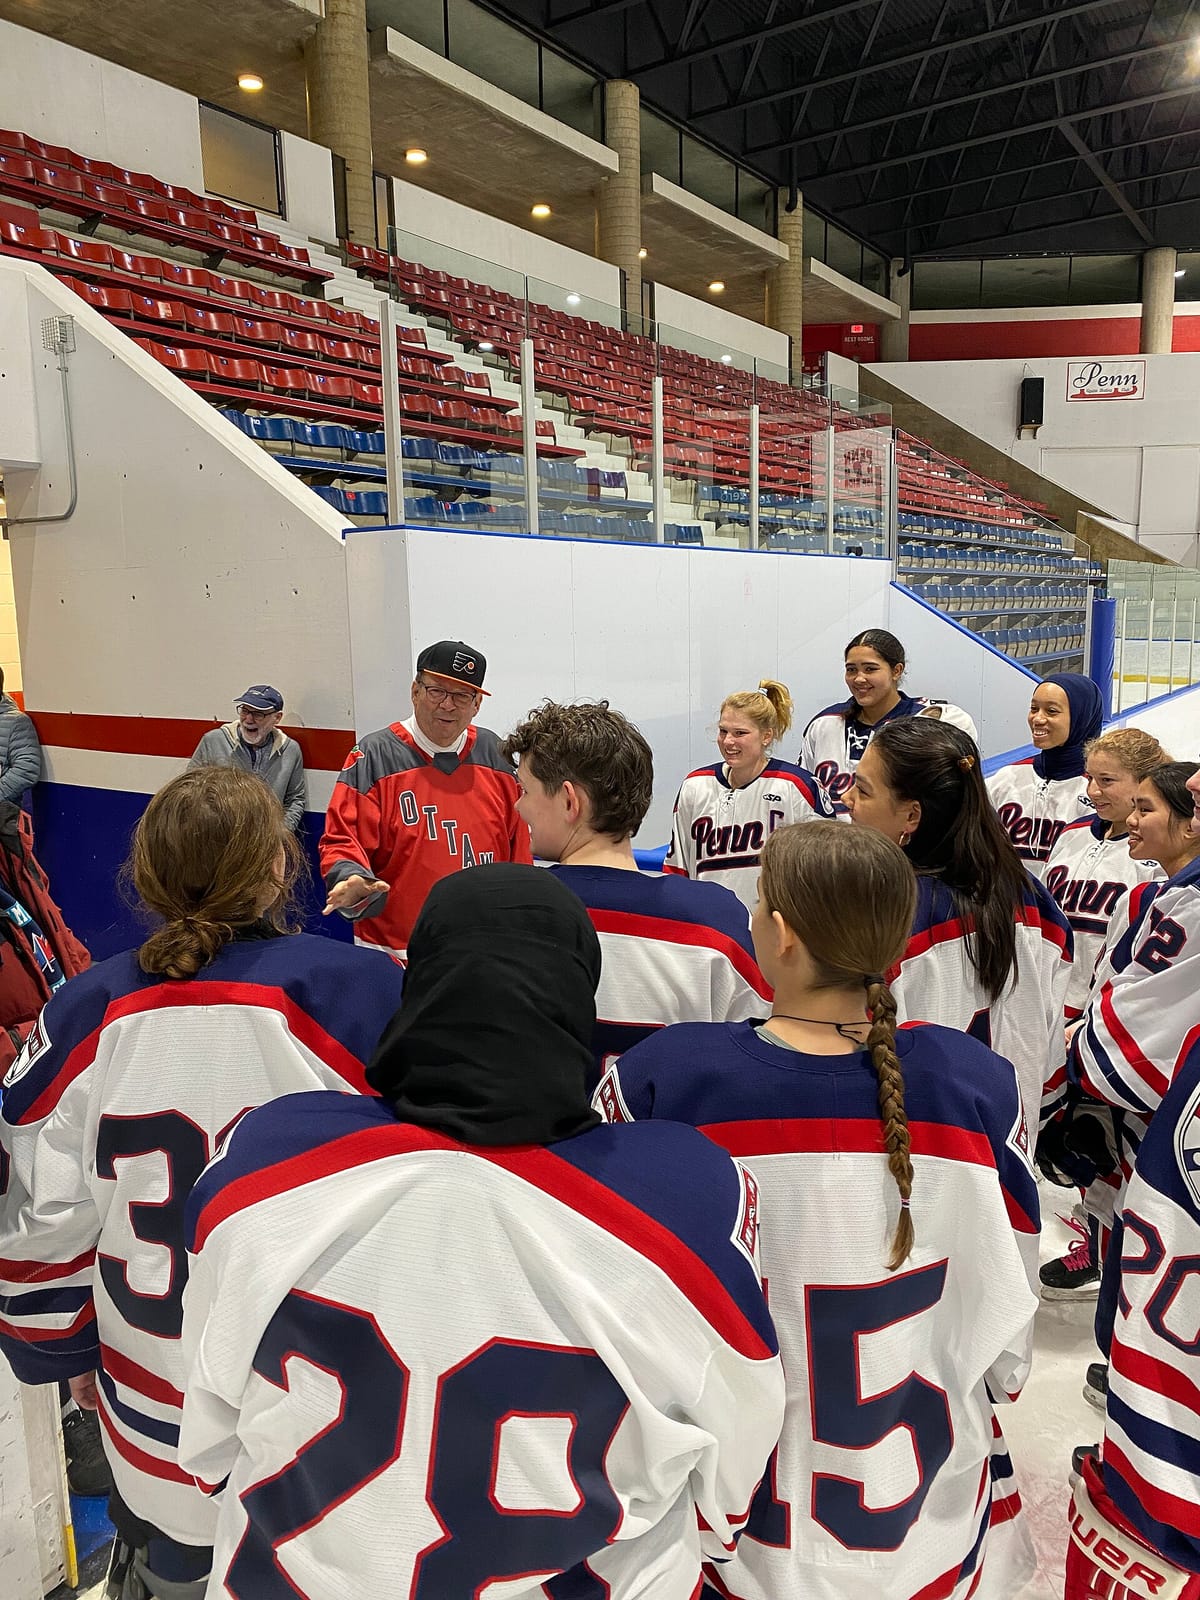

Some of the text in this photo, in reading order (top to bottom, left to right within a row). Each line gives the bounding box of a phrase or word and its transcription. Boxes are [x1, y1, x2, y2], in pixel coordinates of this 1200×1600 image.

[1072, 362, 1138, 388] Penn
[691, 816, 764, 860] Penn
[223, 1287, 631, 1600] 28
